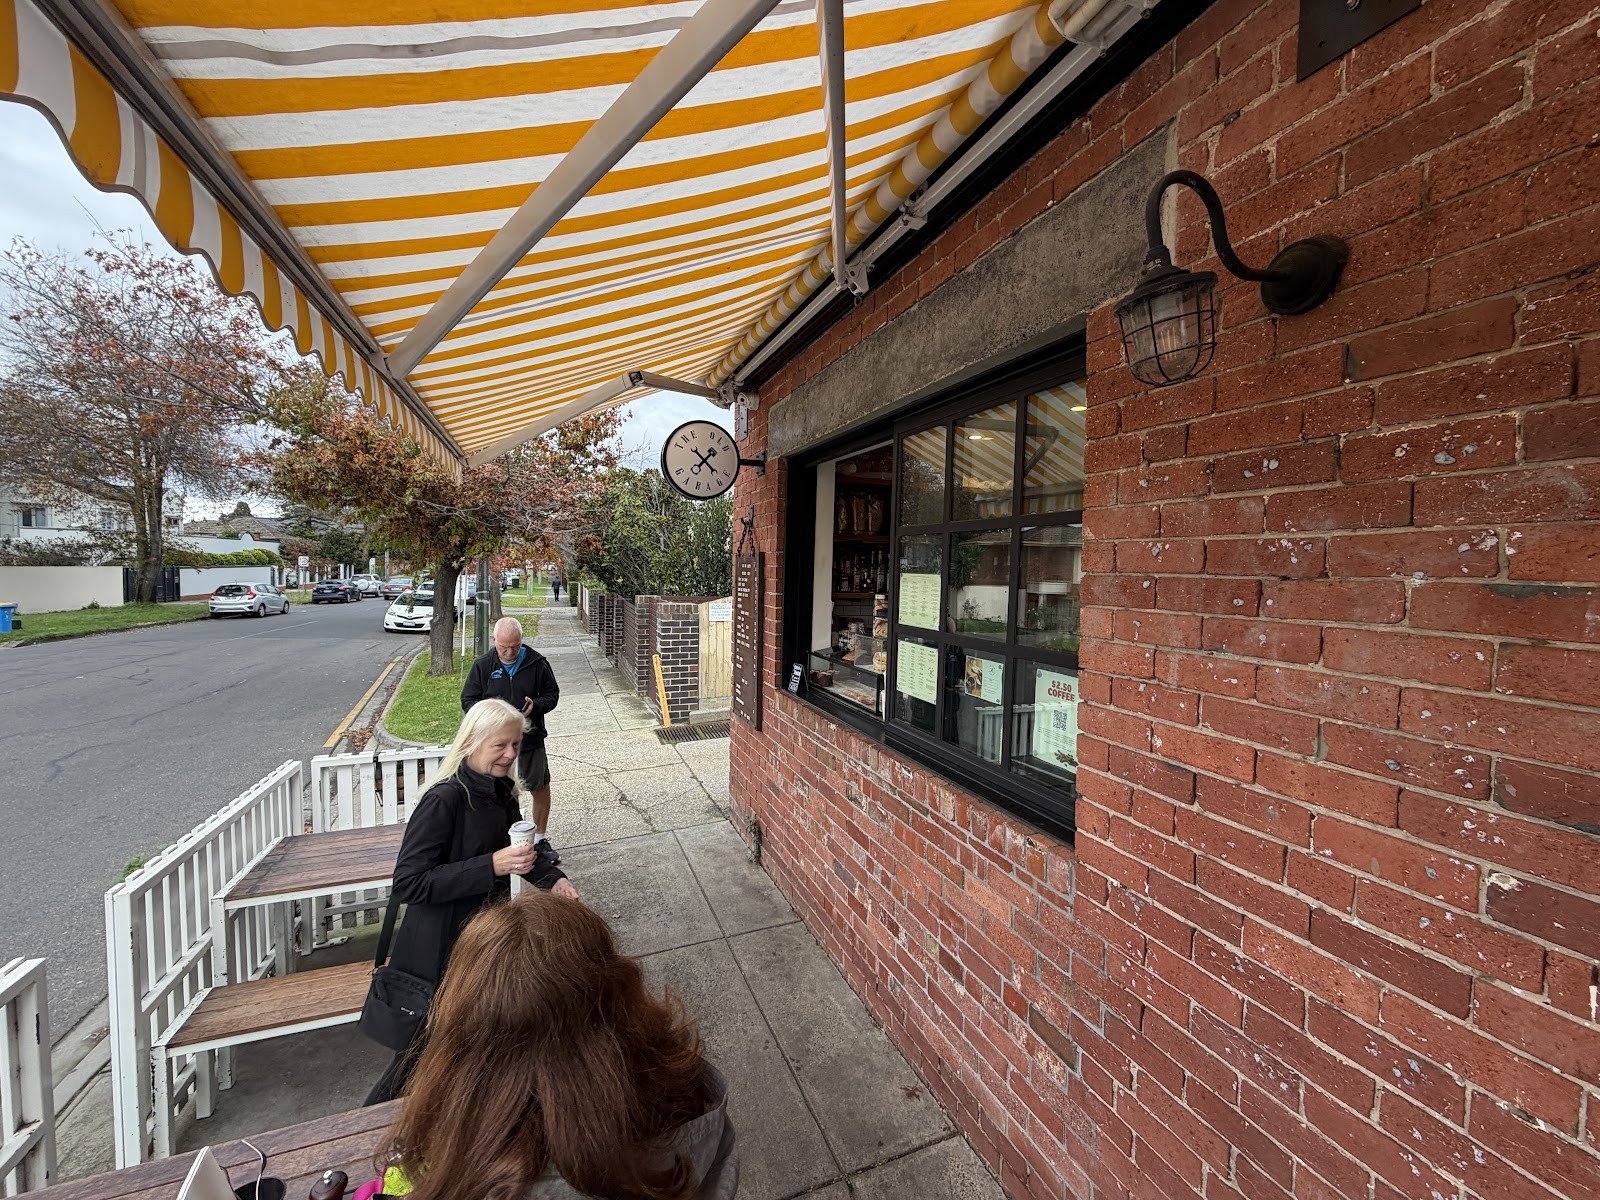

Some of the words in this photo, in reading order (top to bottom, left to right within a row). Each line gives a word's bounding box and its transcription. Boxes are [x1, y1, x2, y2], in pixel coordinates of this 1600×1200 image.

[674, 430, 698, 450] THE
[709, 431, 730, 452] OLD
[674, 468, 731, 491] GARAGE
[1047, 687, 1075, 702] COFFEE
[1051, 680, 1072, 692] $2.50
